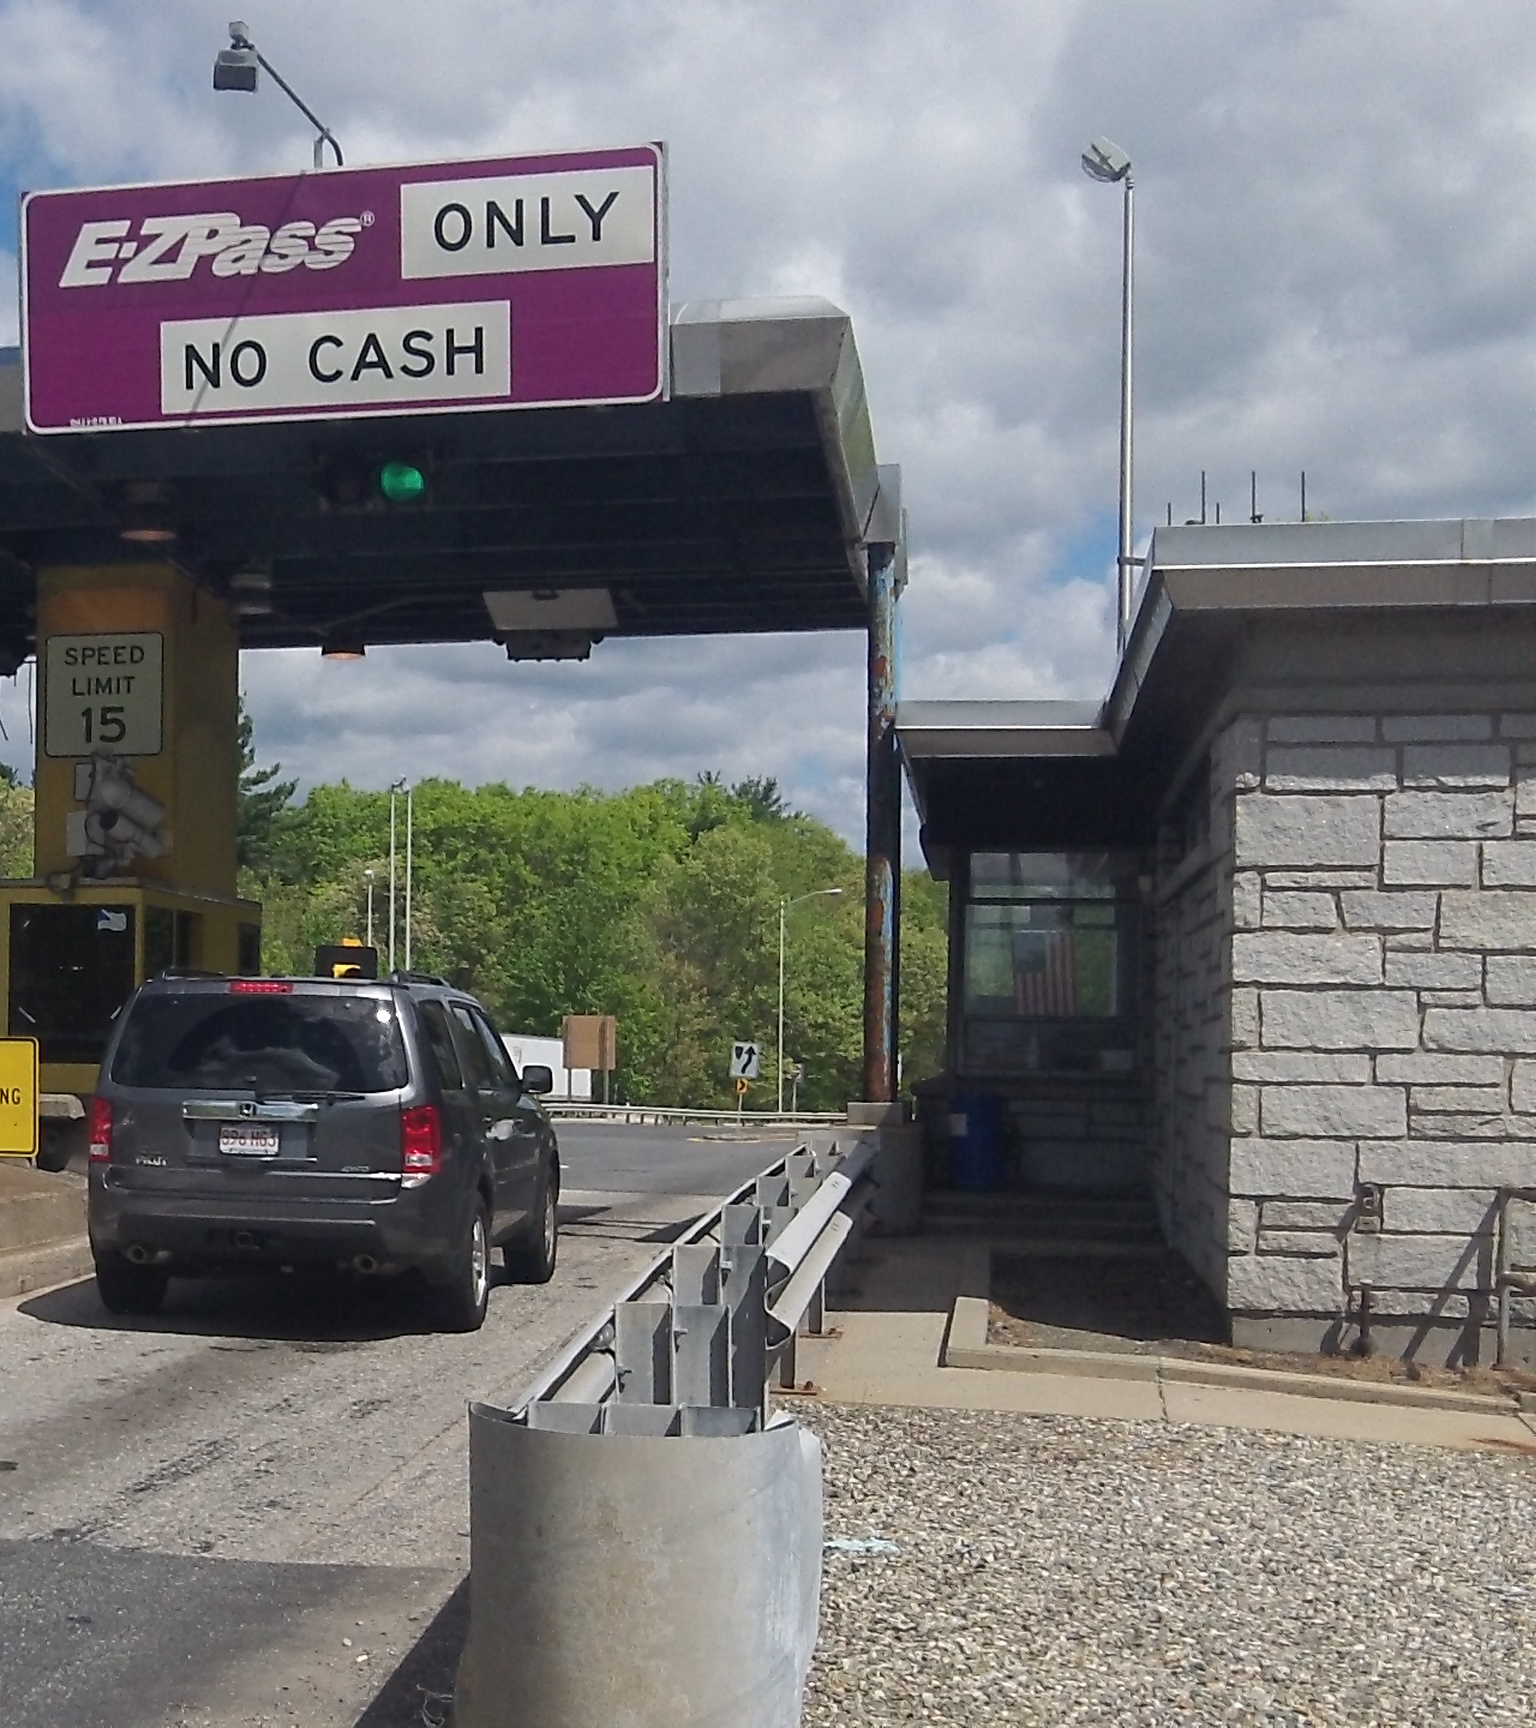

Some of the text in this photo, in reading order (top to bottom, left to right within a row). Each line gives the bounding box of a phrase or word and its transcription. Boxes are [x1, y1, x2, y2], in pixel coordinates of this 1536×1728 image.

[434, 190, 620, 252] ONLY
[184, 326, 485, 390] NO CASH
[64, 645, 145, 667] SPEED
[72, 676, 136, 697] LIMIT
[80, 706, 127, 744] 15
